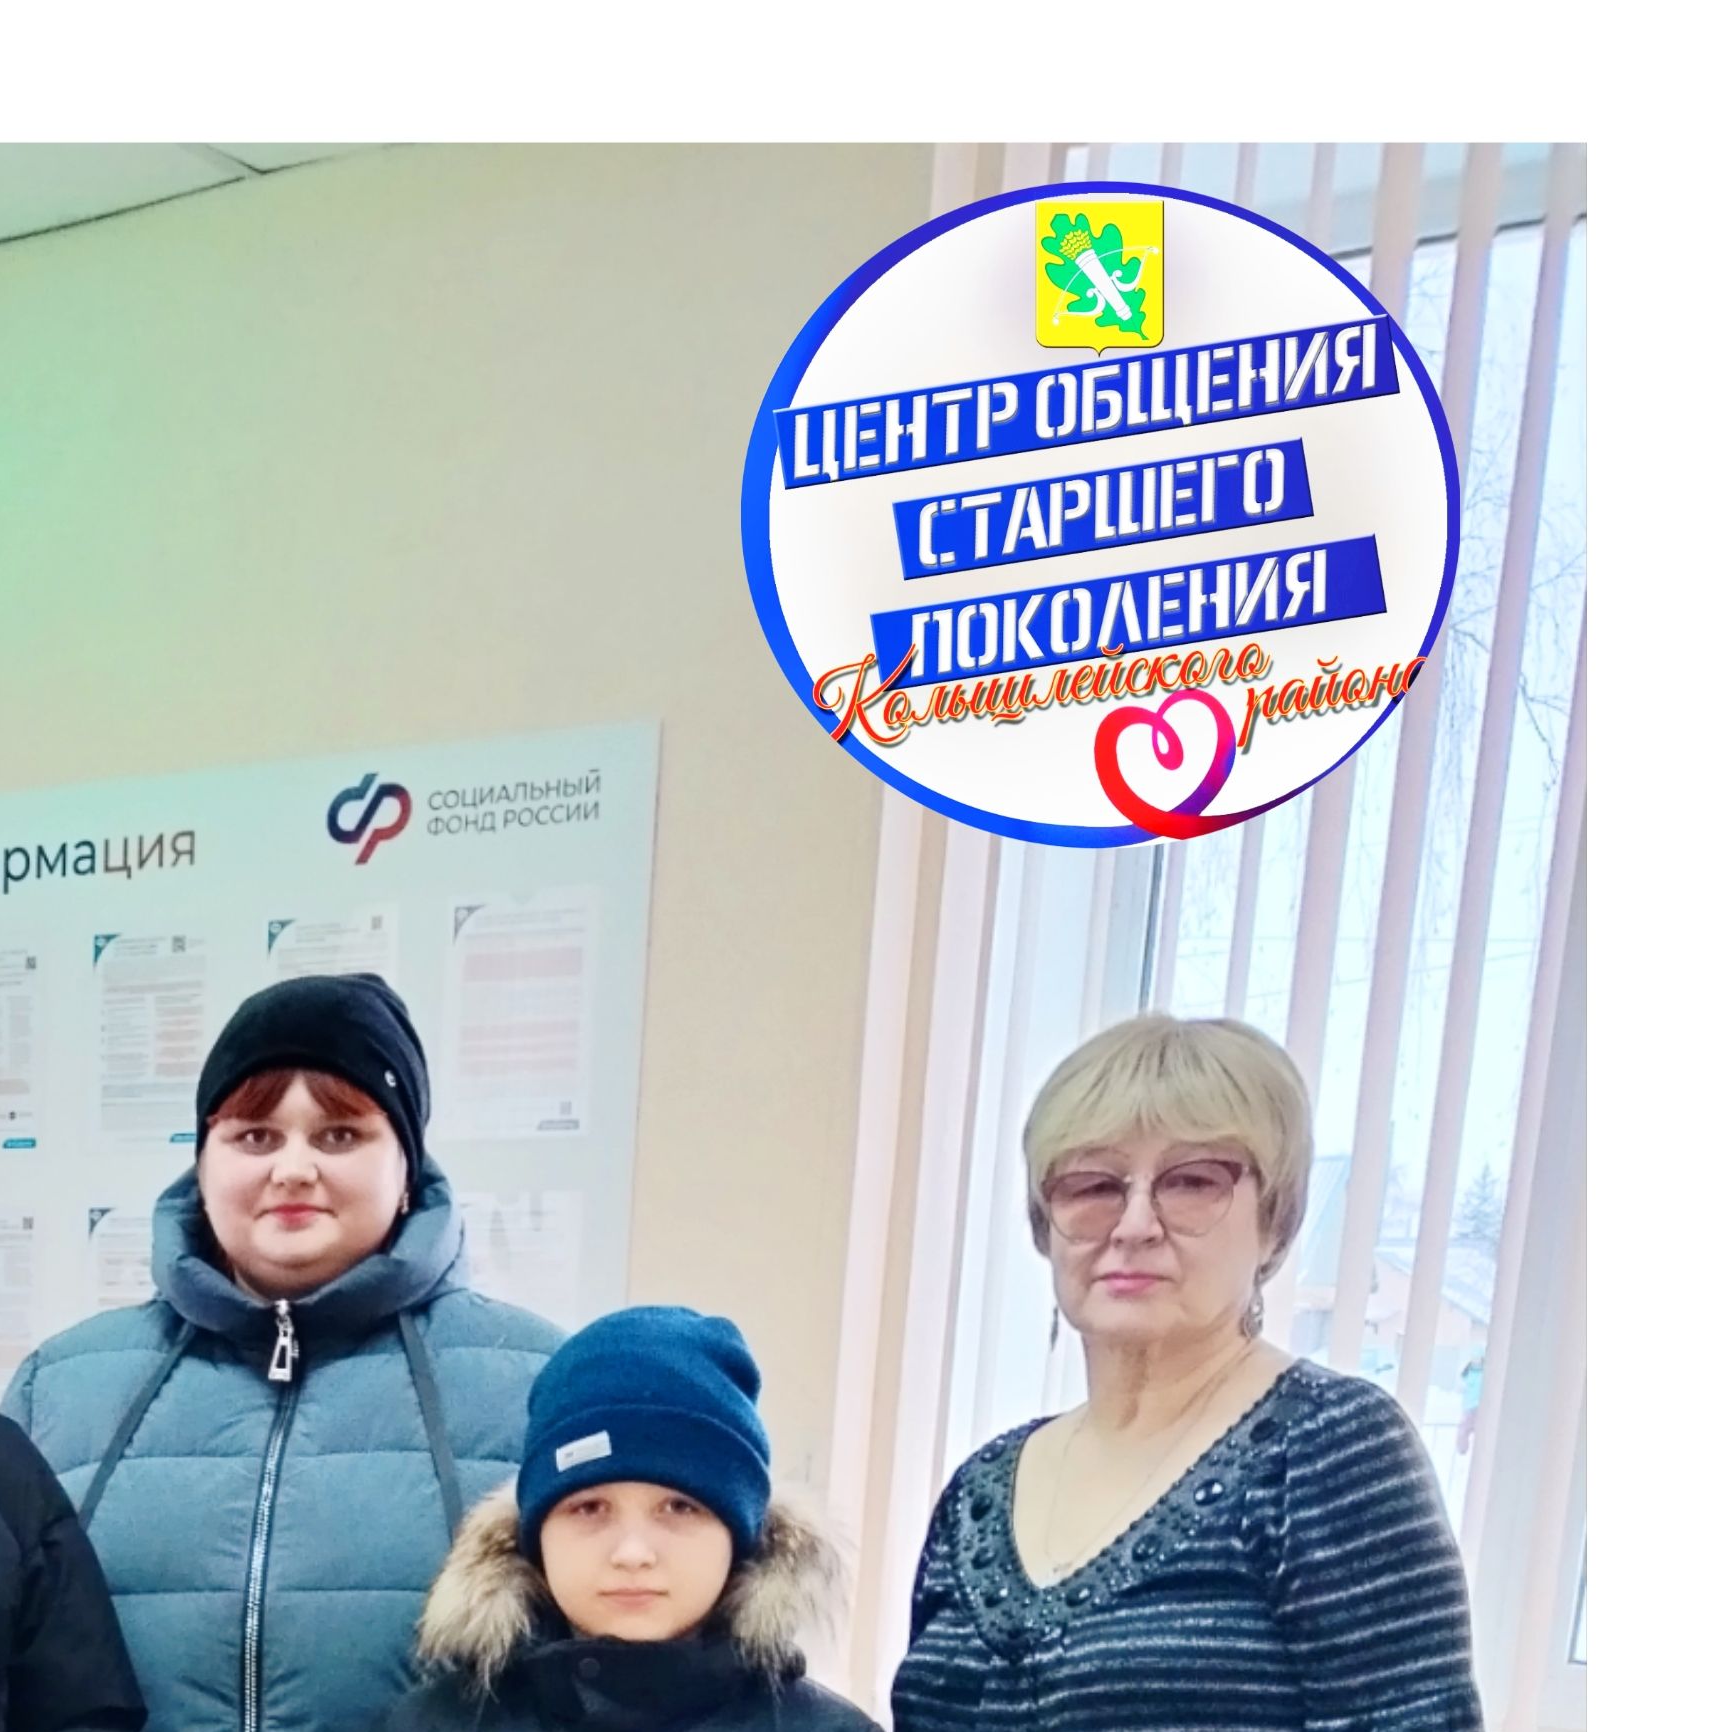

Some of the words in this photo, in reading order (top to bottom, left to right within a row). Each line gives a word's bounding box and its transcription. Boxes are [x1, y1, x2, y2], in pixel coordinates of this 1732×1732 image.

[426, 768, 602, 812] СОЦИАЛЬНЫЙ
[426, 811, 497, 837] ФОНД
[502, 801, 600, 830] РОССИИ
